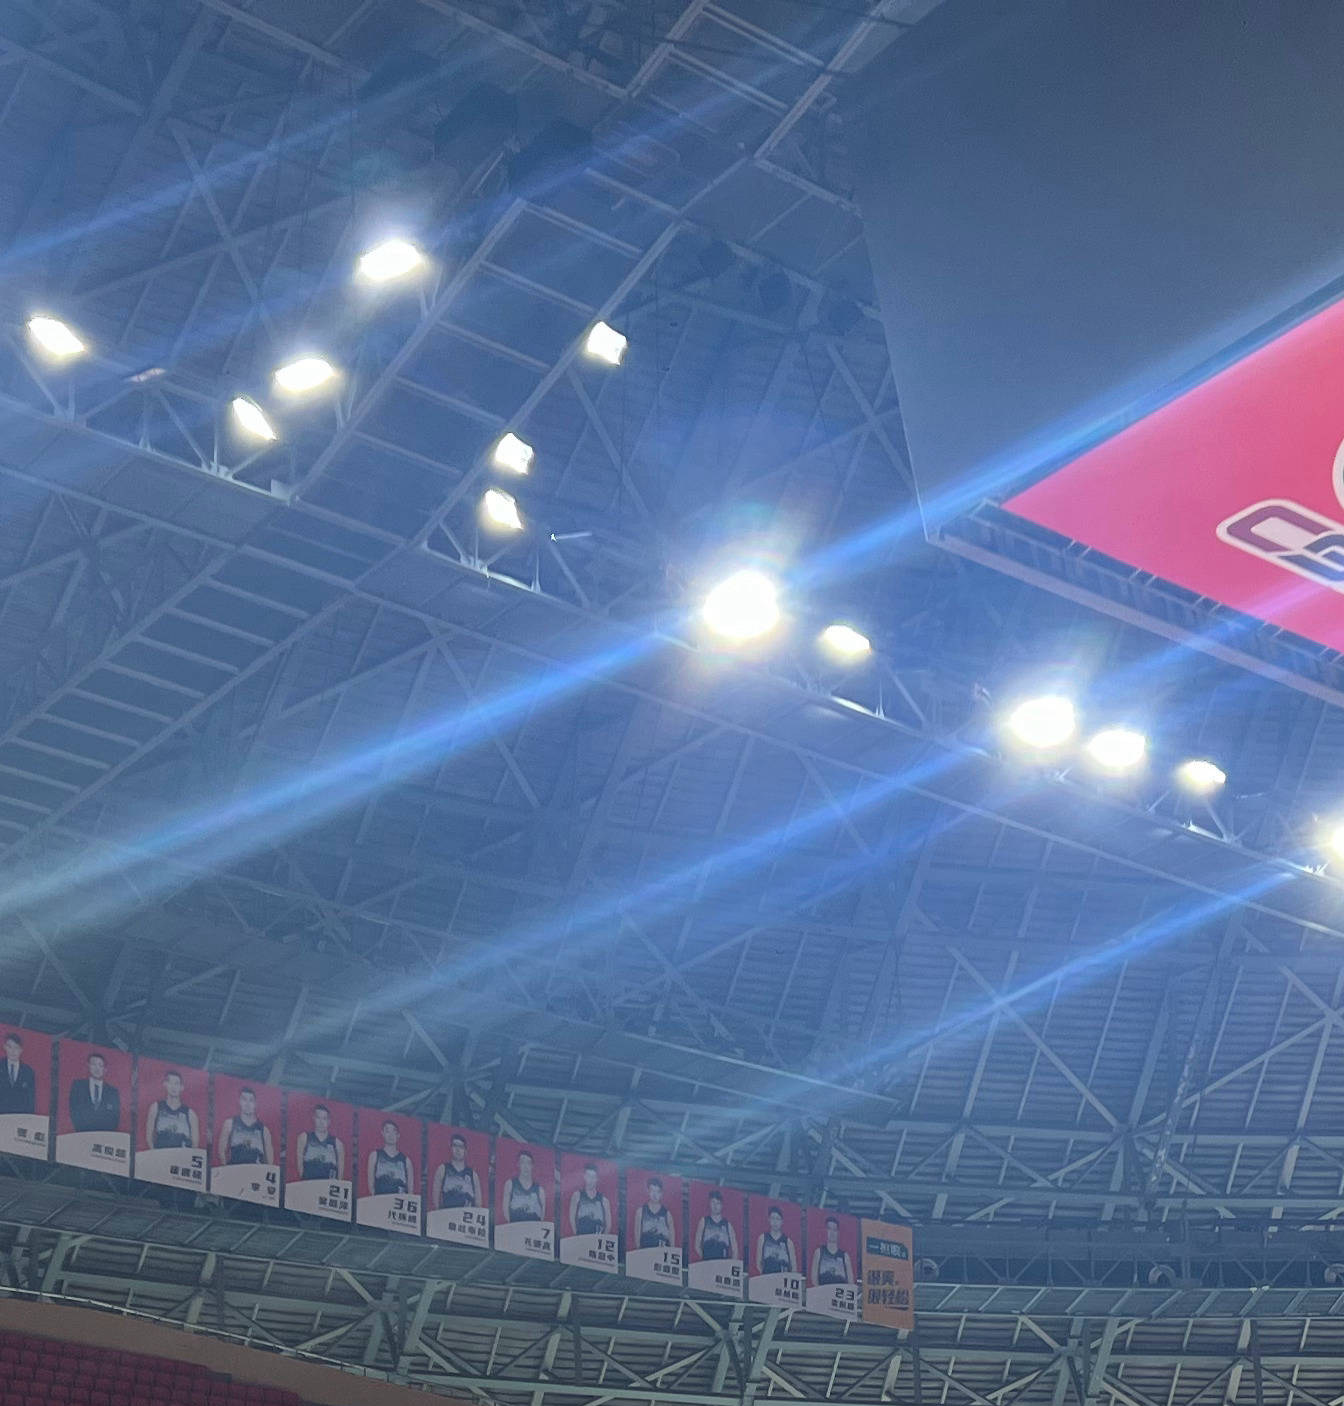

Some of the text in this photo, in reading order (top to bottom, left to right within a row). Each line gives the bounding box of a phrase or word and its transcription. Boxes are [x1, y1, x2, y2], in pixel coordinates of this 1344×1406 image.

[328, 1184, 350, 1200] 21
[393, 1197, 418, 1215] 36
[462, 1211, 487, 1227] 24
[662, 1251, 681, 1266] 15
[834, 1287, 855, 1302] 23
